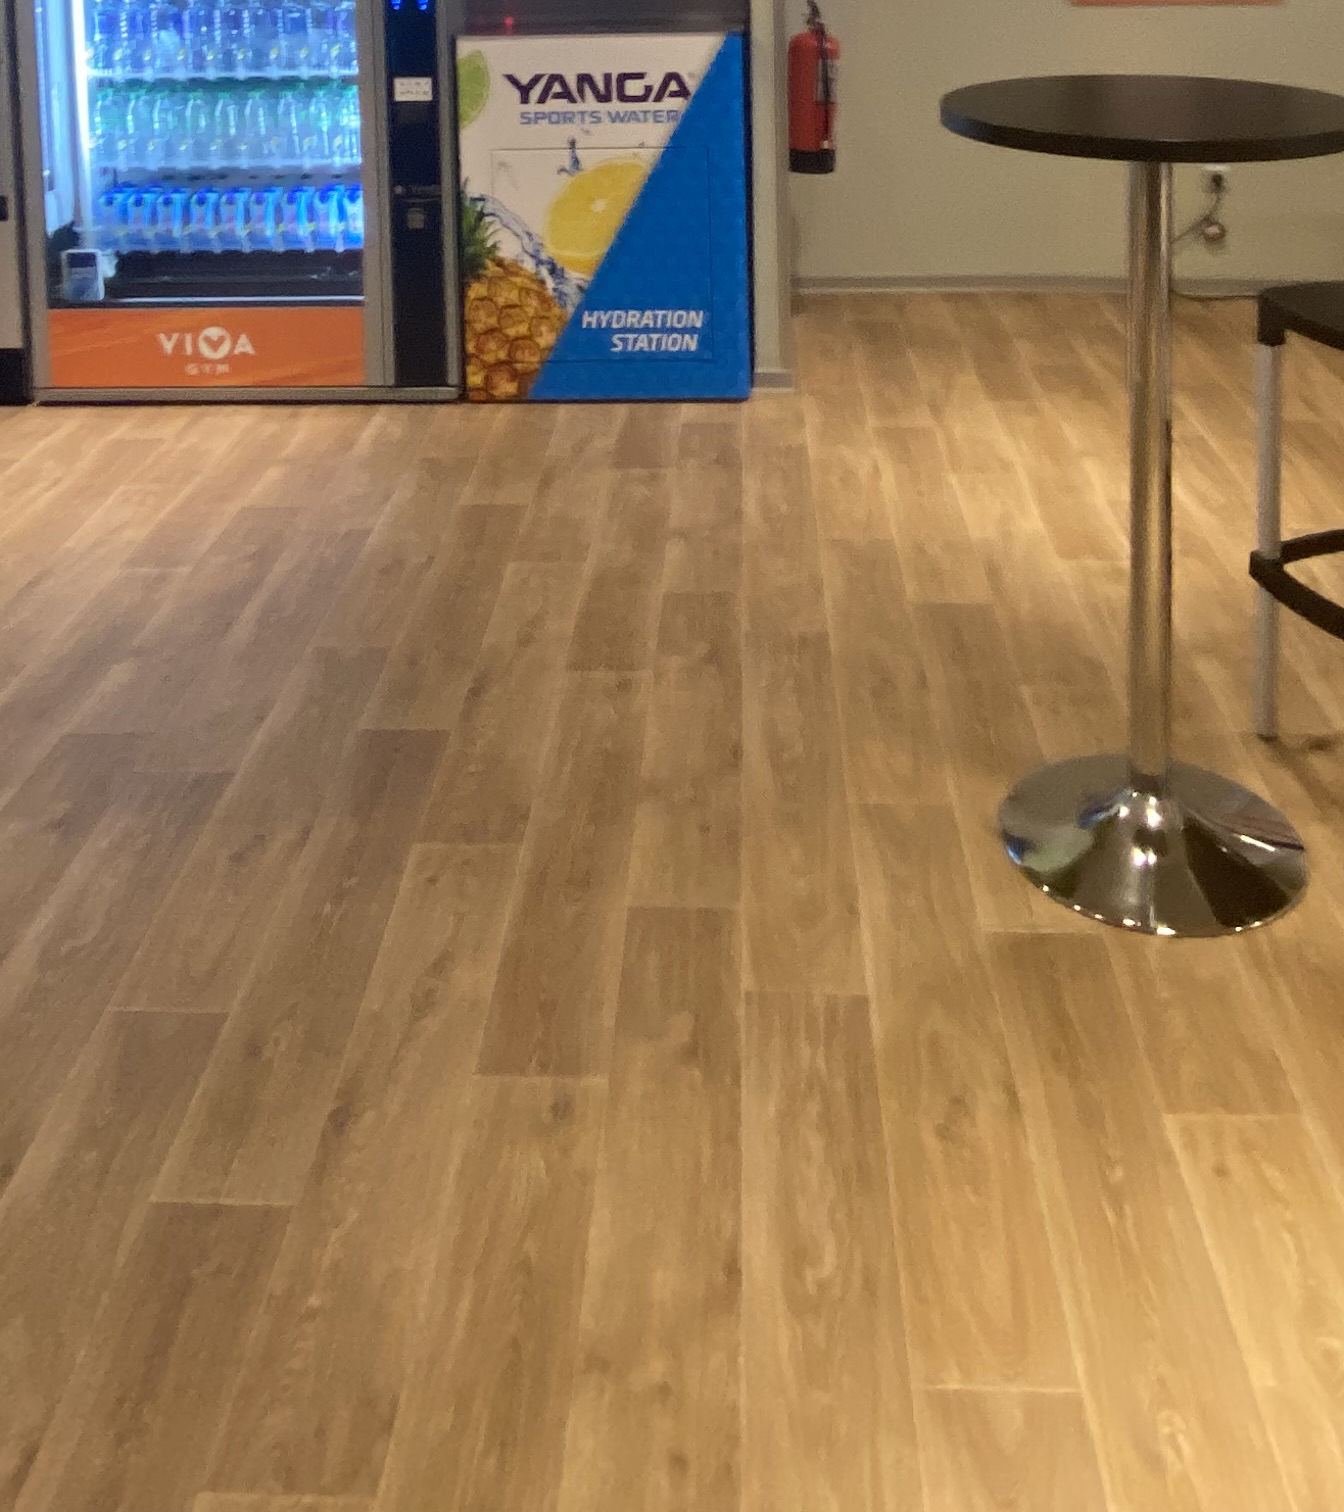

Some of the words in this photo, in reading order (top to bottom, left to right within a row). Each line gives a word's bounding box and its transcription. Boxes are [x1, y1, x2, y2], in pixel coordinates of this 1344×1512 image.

[503, 72, 691, 104] YANGA
[520, 110, 601, 125] SPORTS
[607, 109, 680, 124] WATER
[582, 310, 704, 329] HYDRATION
[609, 333, 699, 352] STATION
